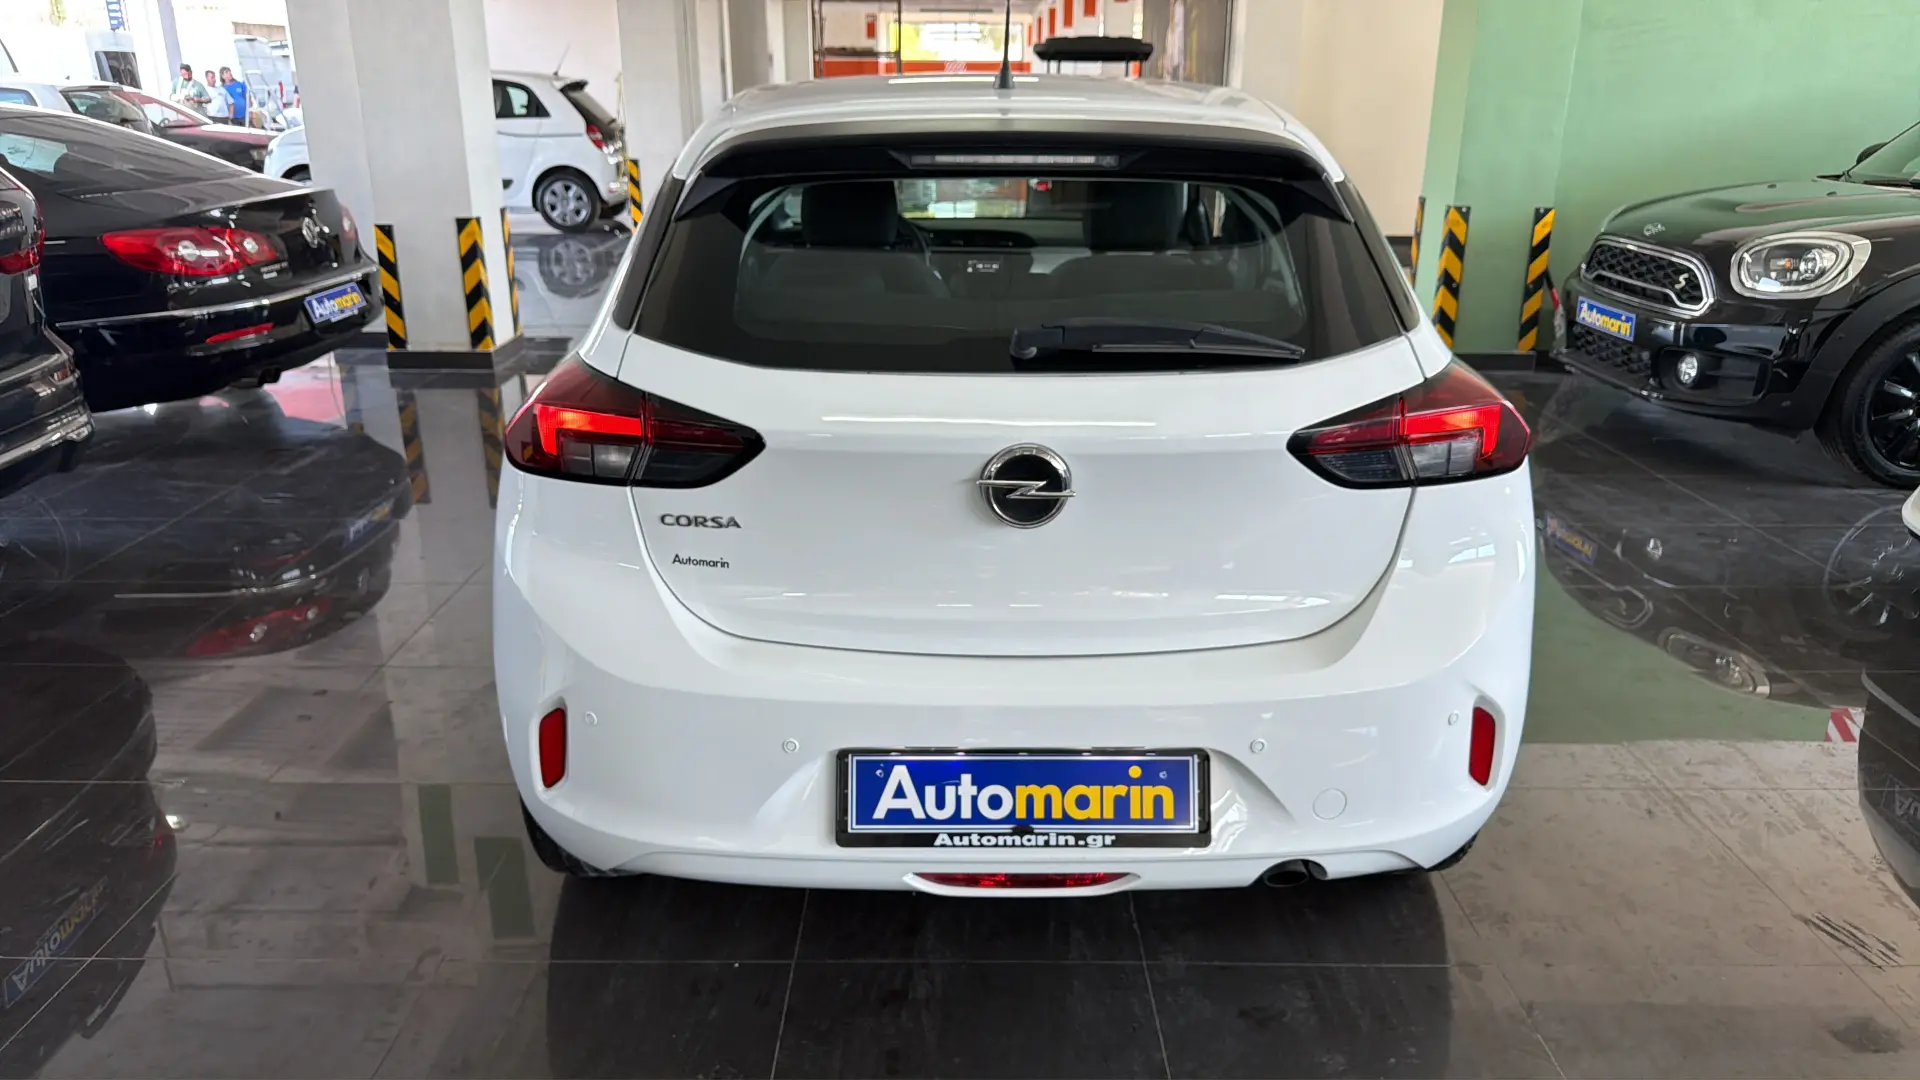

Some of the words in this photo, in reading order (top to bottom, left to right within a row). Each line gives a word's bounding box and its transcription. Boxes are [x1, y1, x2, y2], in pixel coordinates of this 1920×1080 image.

[1580, 302, 1632, 336] Automarin
[660, 513, 742, 529] CORSA
[672, 553, 730, 569] Automarin
[872, 764, 1175, 820] Automarin
[933, 832, 1116, 848] Automarin.gr
